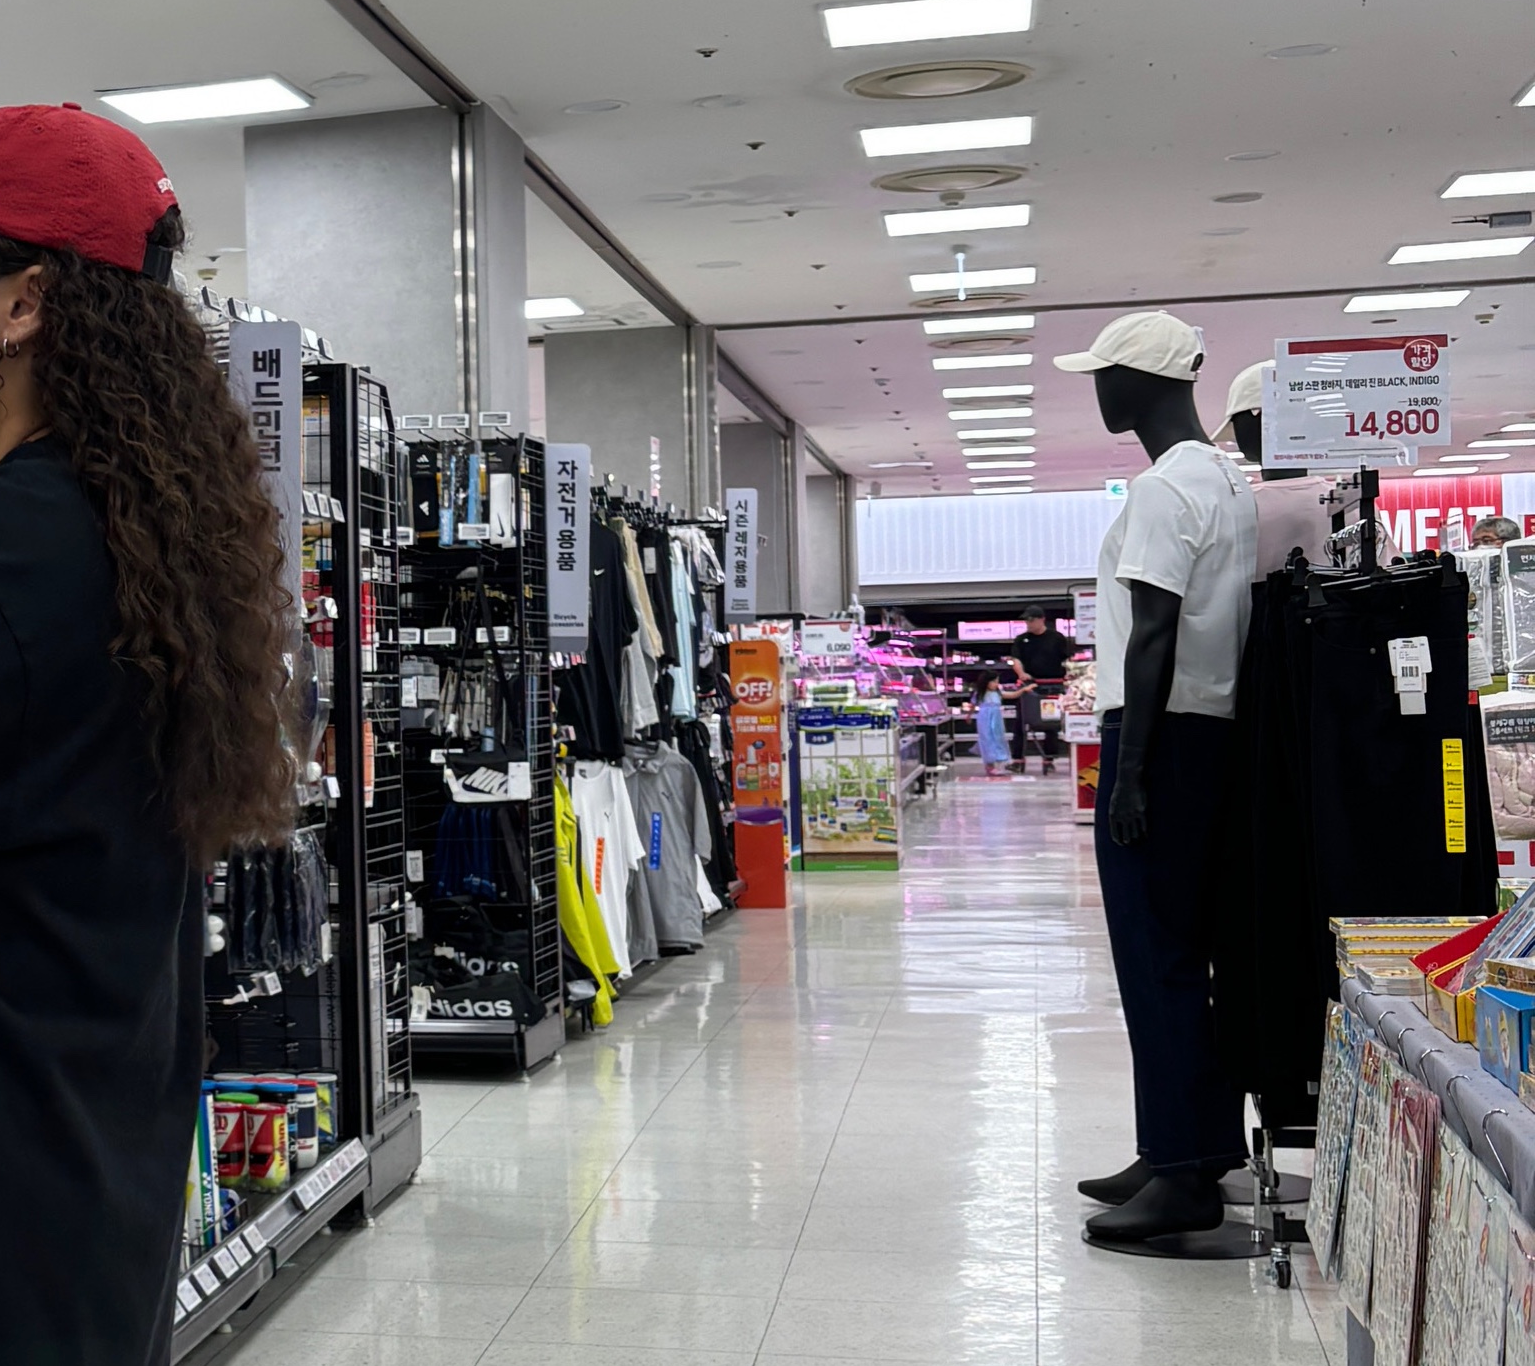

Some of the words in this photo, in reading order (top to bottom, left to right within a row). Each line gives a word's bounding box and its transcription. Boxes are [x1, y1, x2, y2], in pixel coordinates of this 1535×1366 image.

[1345, 377, 1368, 390] 데일리
[1368, 377, 1377, 389] 진
[1377, 376, 1409, 388] BLACK,
[1408, 374, 1440, 386] INDIGO
[1344, 408, 1440, 440] 14,800
[557, 459, 579, 572] 자전거용품
[1379, 505, 1496, 553] MEAT
[735, 682, 774, 699] OFF!
[426, 997, 514, 1019] didas
[202, 1190, 215, 1224] YONEX
